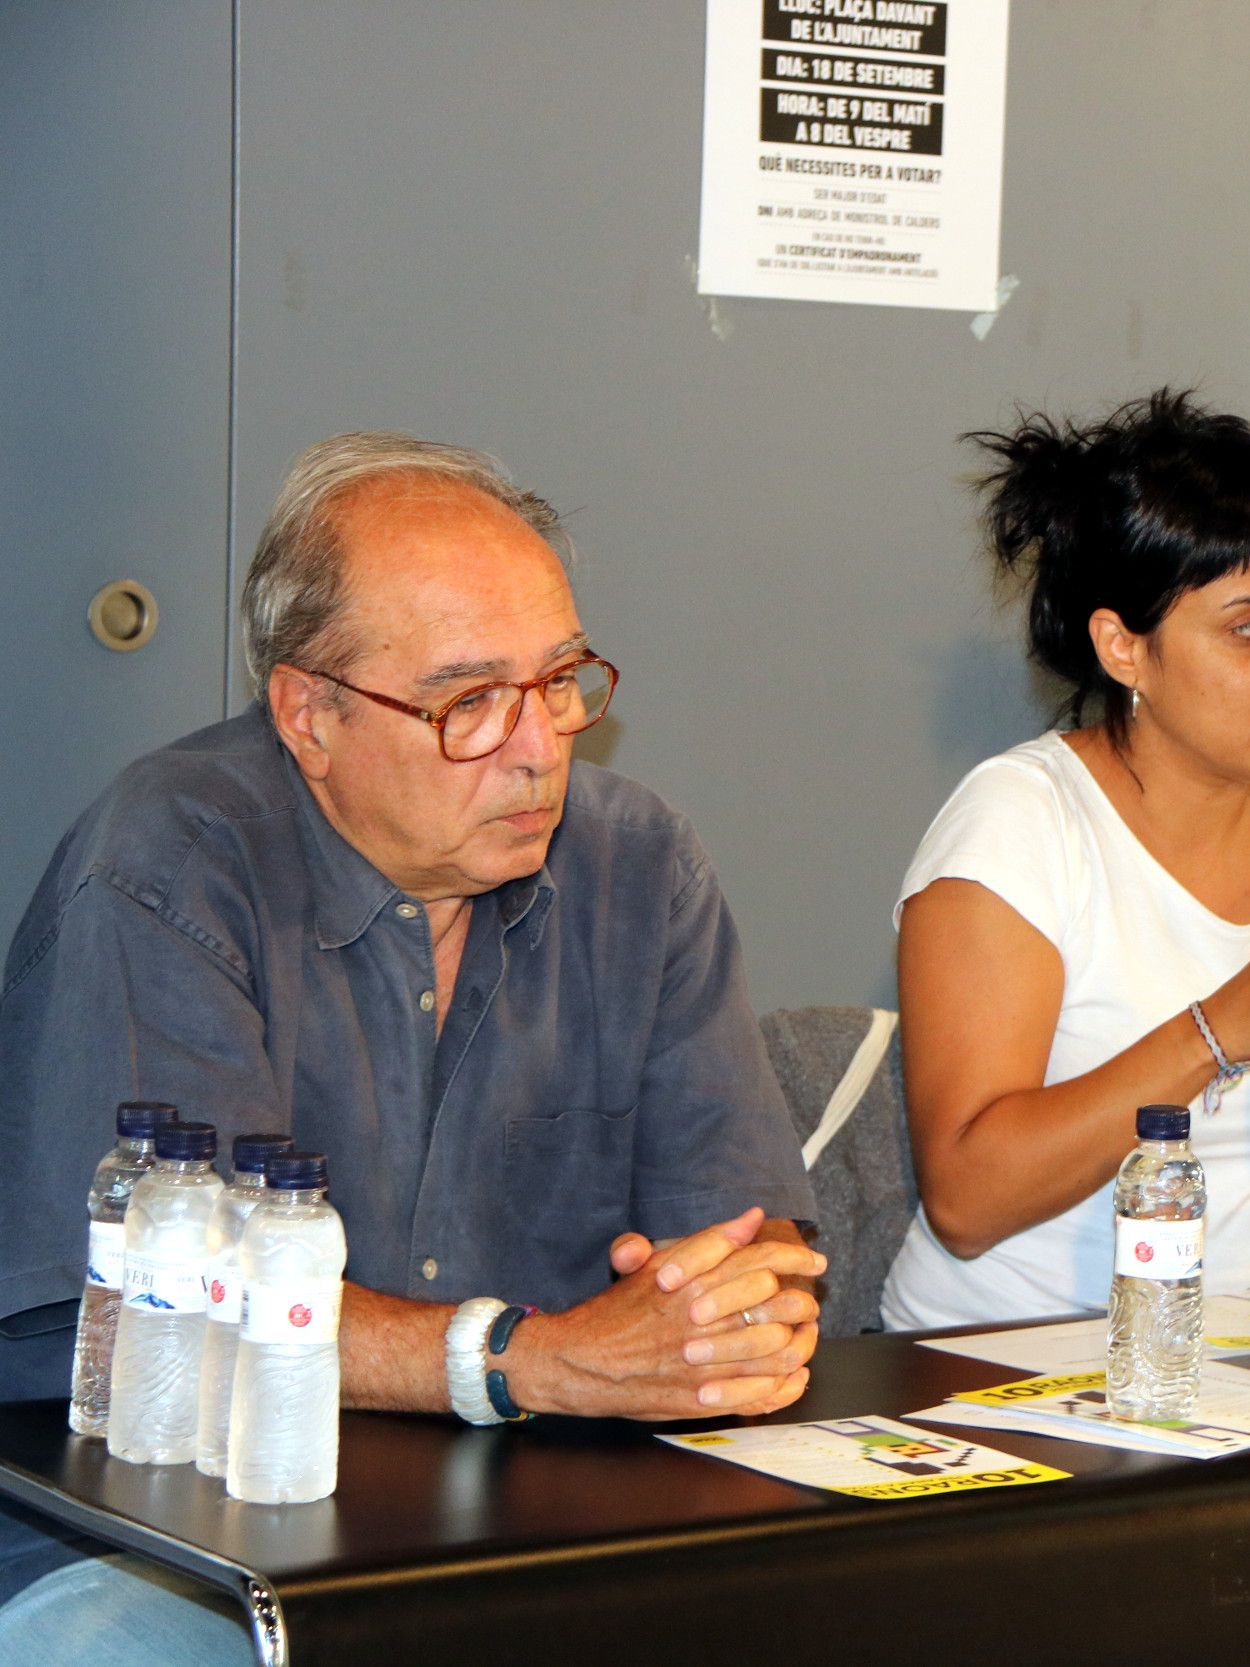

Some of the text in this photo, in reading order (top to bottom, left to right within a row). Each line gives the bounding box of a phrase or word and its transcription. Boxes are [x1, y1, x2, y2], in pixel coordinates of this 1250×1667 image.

[823, 0, 874, 22] PLAÇA
[875, 2, 937, 26] DAVANT
[790, 19, 812, 41] DE
[776, 55, 935, 89] DIA: 18 DE SETEMBRE
[776, 93, 932, 126] HORA: DE 9 DEL MATÍ
[795, 121, 808, 142] A
[822, 123, 852, 146] DEL
[853, 126, 913, 150] VESPRE
[759, 153, 942, 186] QUÈ NECESSITES PER A VOTAR?
[981, 1386, 1044, 1400] 10
[972, 1468, 1042, 1483] 10
